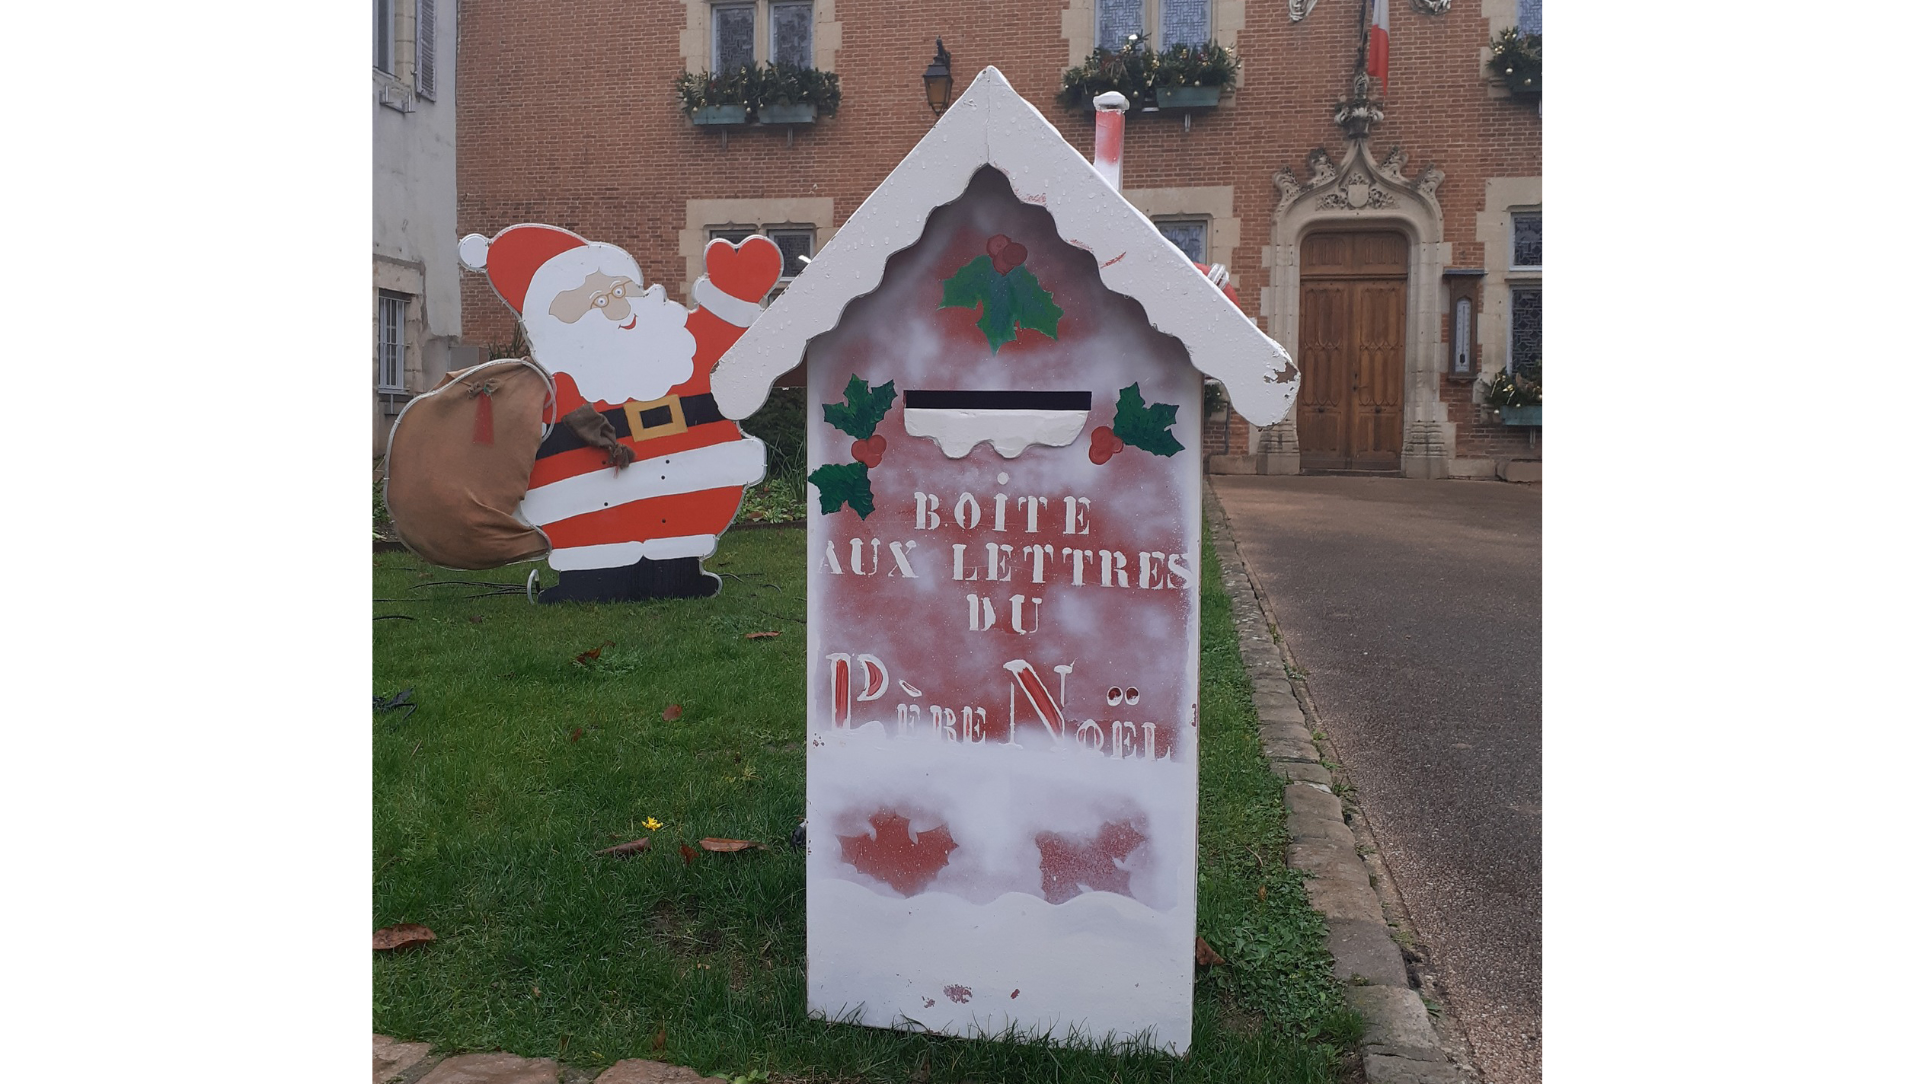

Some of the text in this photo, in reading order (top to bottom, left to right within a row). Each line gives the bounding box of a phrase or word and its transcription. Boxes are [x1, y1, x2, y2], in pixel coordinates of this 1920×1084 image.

[819, 537, 1193, 590] AUX LETTRES
[966, 593, 1043, 634] DU
